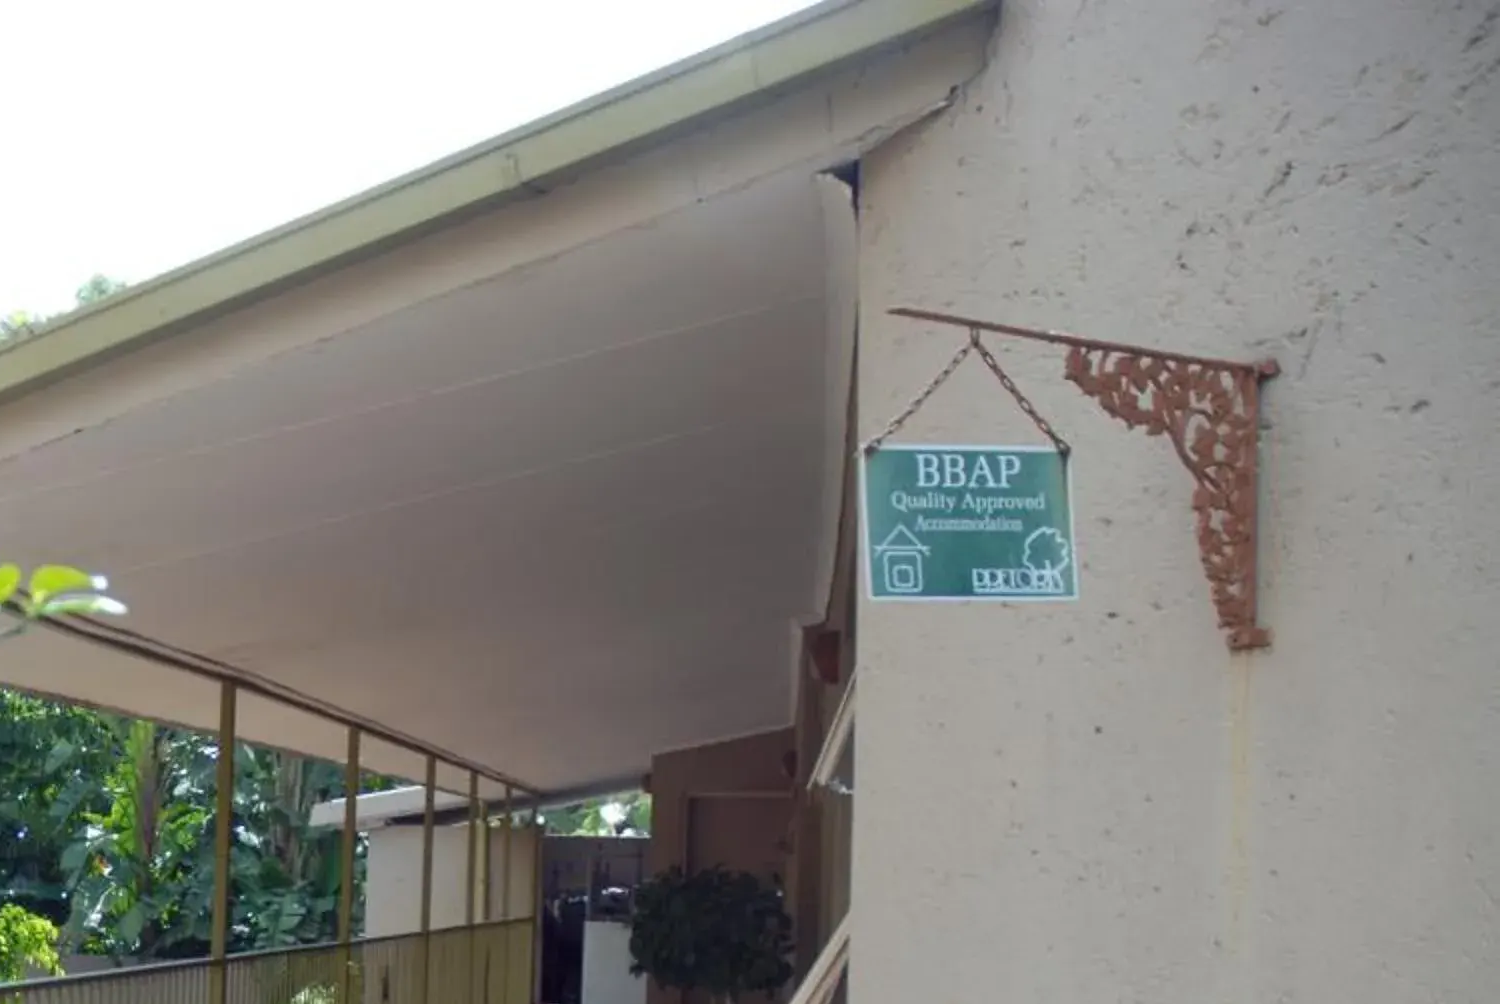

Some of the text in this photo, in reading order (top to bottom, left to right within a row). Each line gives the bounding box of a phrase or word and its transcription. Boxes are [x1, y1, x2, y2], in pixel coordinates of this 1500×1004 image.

[916, 453, 1021, 488] BBAP
[891, 491, 1045, 514] Quality Approved
